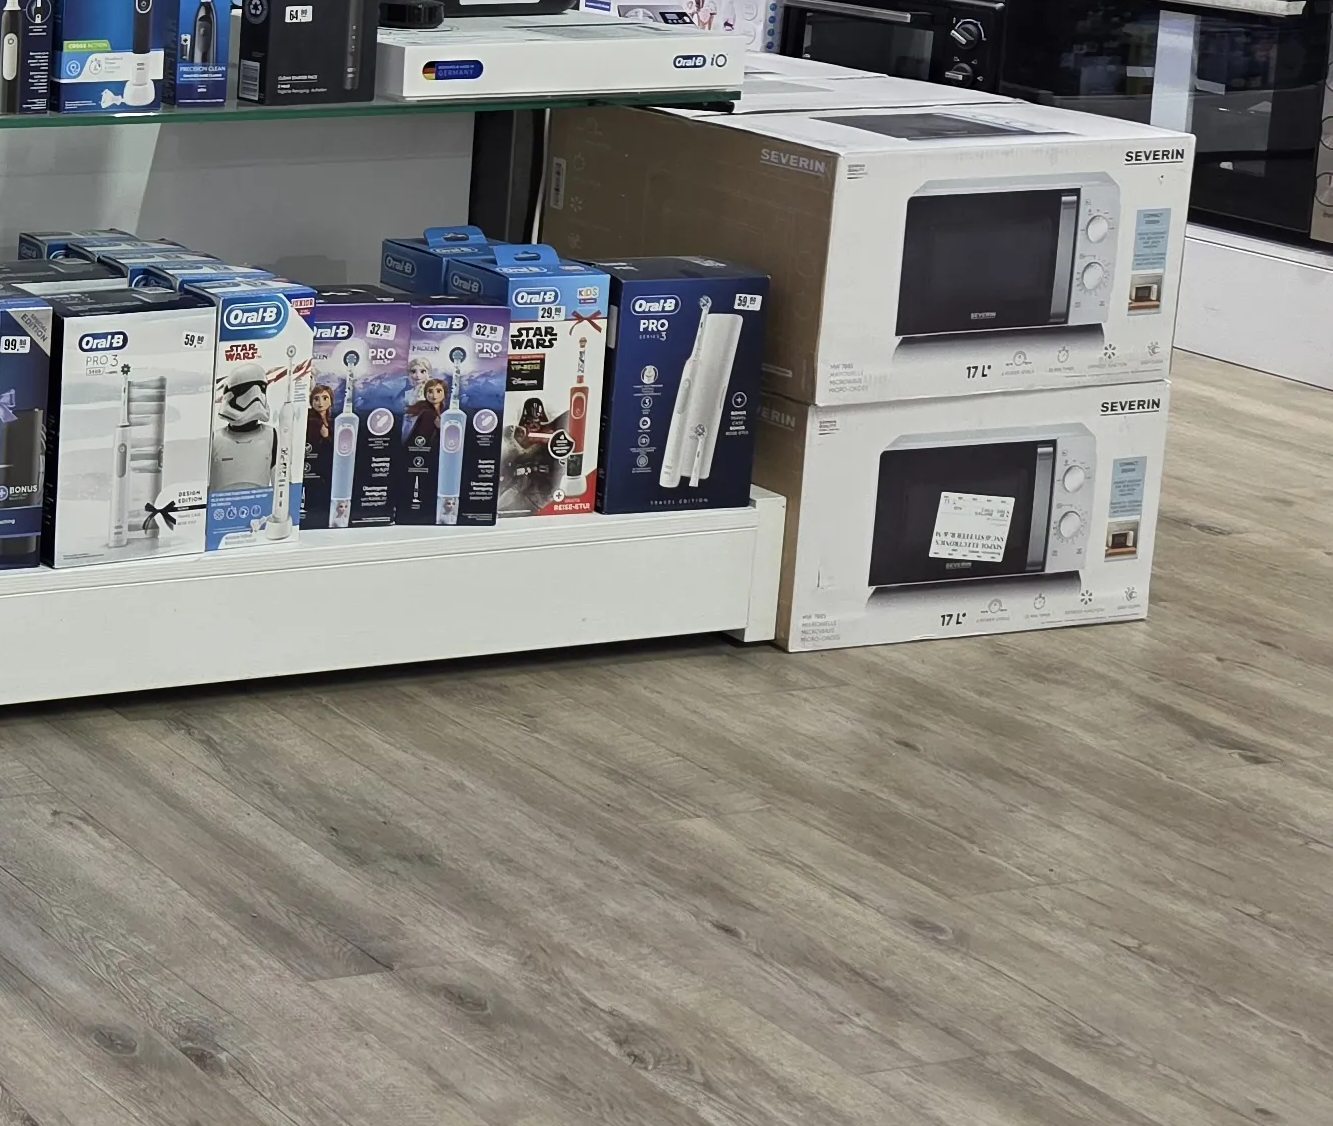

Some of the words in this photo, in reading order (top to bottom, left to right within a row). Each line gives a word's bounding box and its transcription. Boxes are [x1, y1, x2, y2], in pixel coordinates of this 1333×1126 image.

[674, 56, 705, 67] Oral-B
[710, 53, 728, 68] iO
[180, 65, 209, 73] PRECISION
[761, 148, 825, 175] SEVERIN
[1124, 149, 1185, 164] SEVERIN
[386, 257, 414, 274] Oral-B
[452, 276, 480, 293] Oral-B
[516, 291, 555, 304] Oral-B
[577, 287, 599, 299] KIDS
[635, 299, 676, 312] Oral-B
[229, 307, 278, 324] Oral-B
[970, 311, 996, 319] SEVERIN
[19, 313, 49, 344] EDITION
[421, 317, 465, 330] Oral-B
[639, 319, 669, 332] PRO
[510, 326, 558, 340] STAR
[81, 335, 124, 350] Oral-B
[227, 343, 257, 354] STAR
[474, 342, 503, 354] PRO
[510, 337, 558, 351] WARS
[85, 355, 109, 367] PRO
[109, 354, 120, 367] 3
[225, 350, 258, 362] WARS
[368, 348, 396, 360] PRO
[1100, 397, 1161, 414] SEVERIN
[9, 484, 39, 495] BONUS
[178, 490, 201, 498] DESIGN
[178, 496, 203, 504] EDITION
[650, 498, 677, 506] TRAVEL
[678, 497, 709, 505] EDITION
[553, 503, 591, 512] REISE-ETUI
